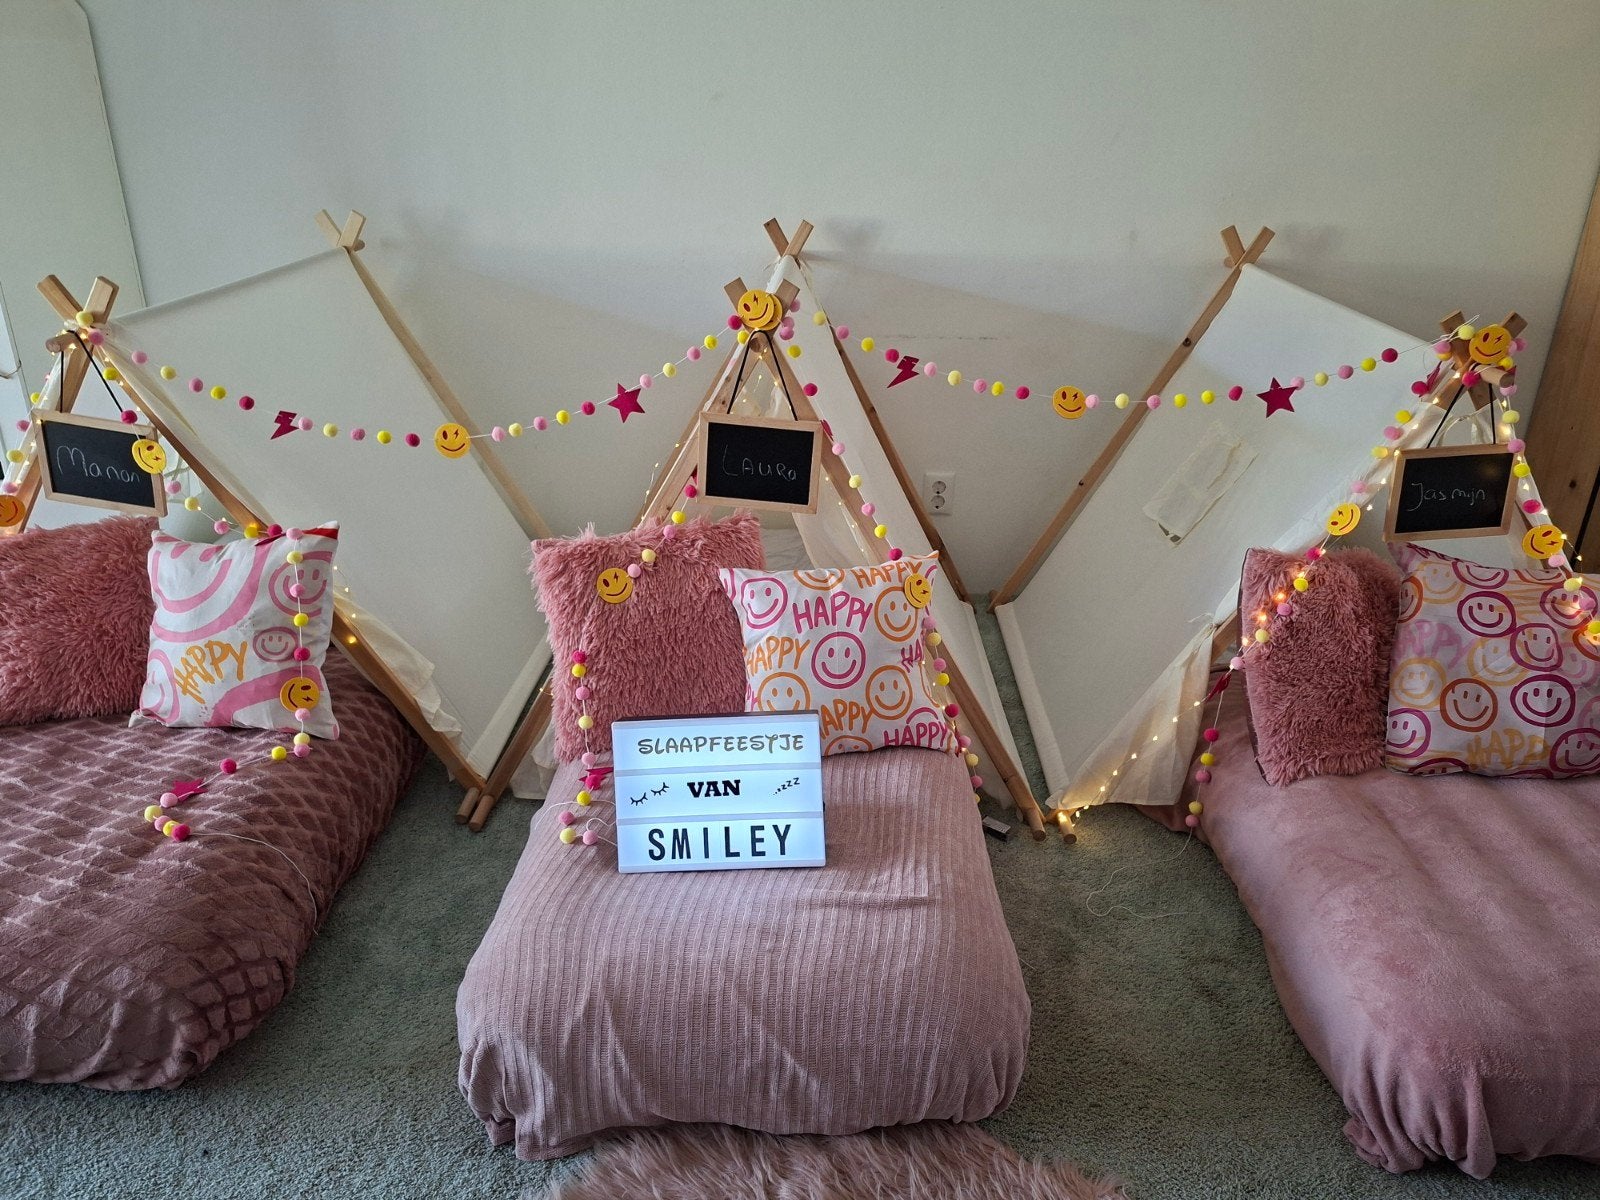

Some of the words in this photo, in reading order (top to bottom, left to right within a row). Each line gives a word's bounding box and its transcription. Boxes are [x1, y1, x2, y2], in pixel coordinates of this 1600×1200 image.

[56, 445, 141, 483] Manon
[850, 561, 923, 589] HAPPY
[792, 590, 873, 634] HAPPY
[1390, 619, 1475, 673] APPY
[174, 640, 248, 705] HAPPY
[819, 698, 875, 740] APPY
[883, 721, 948, 748] HAPPY
[637, 733, 804, 755] SLAAPFEESTJE
[1466, 727, 1552, 770] HAPP
[686, 779, 741, 798] VAN
[648, 824, 792, 861] SMILEY
